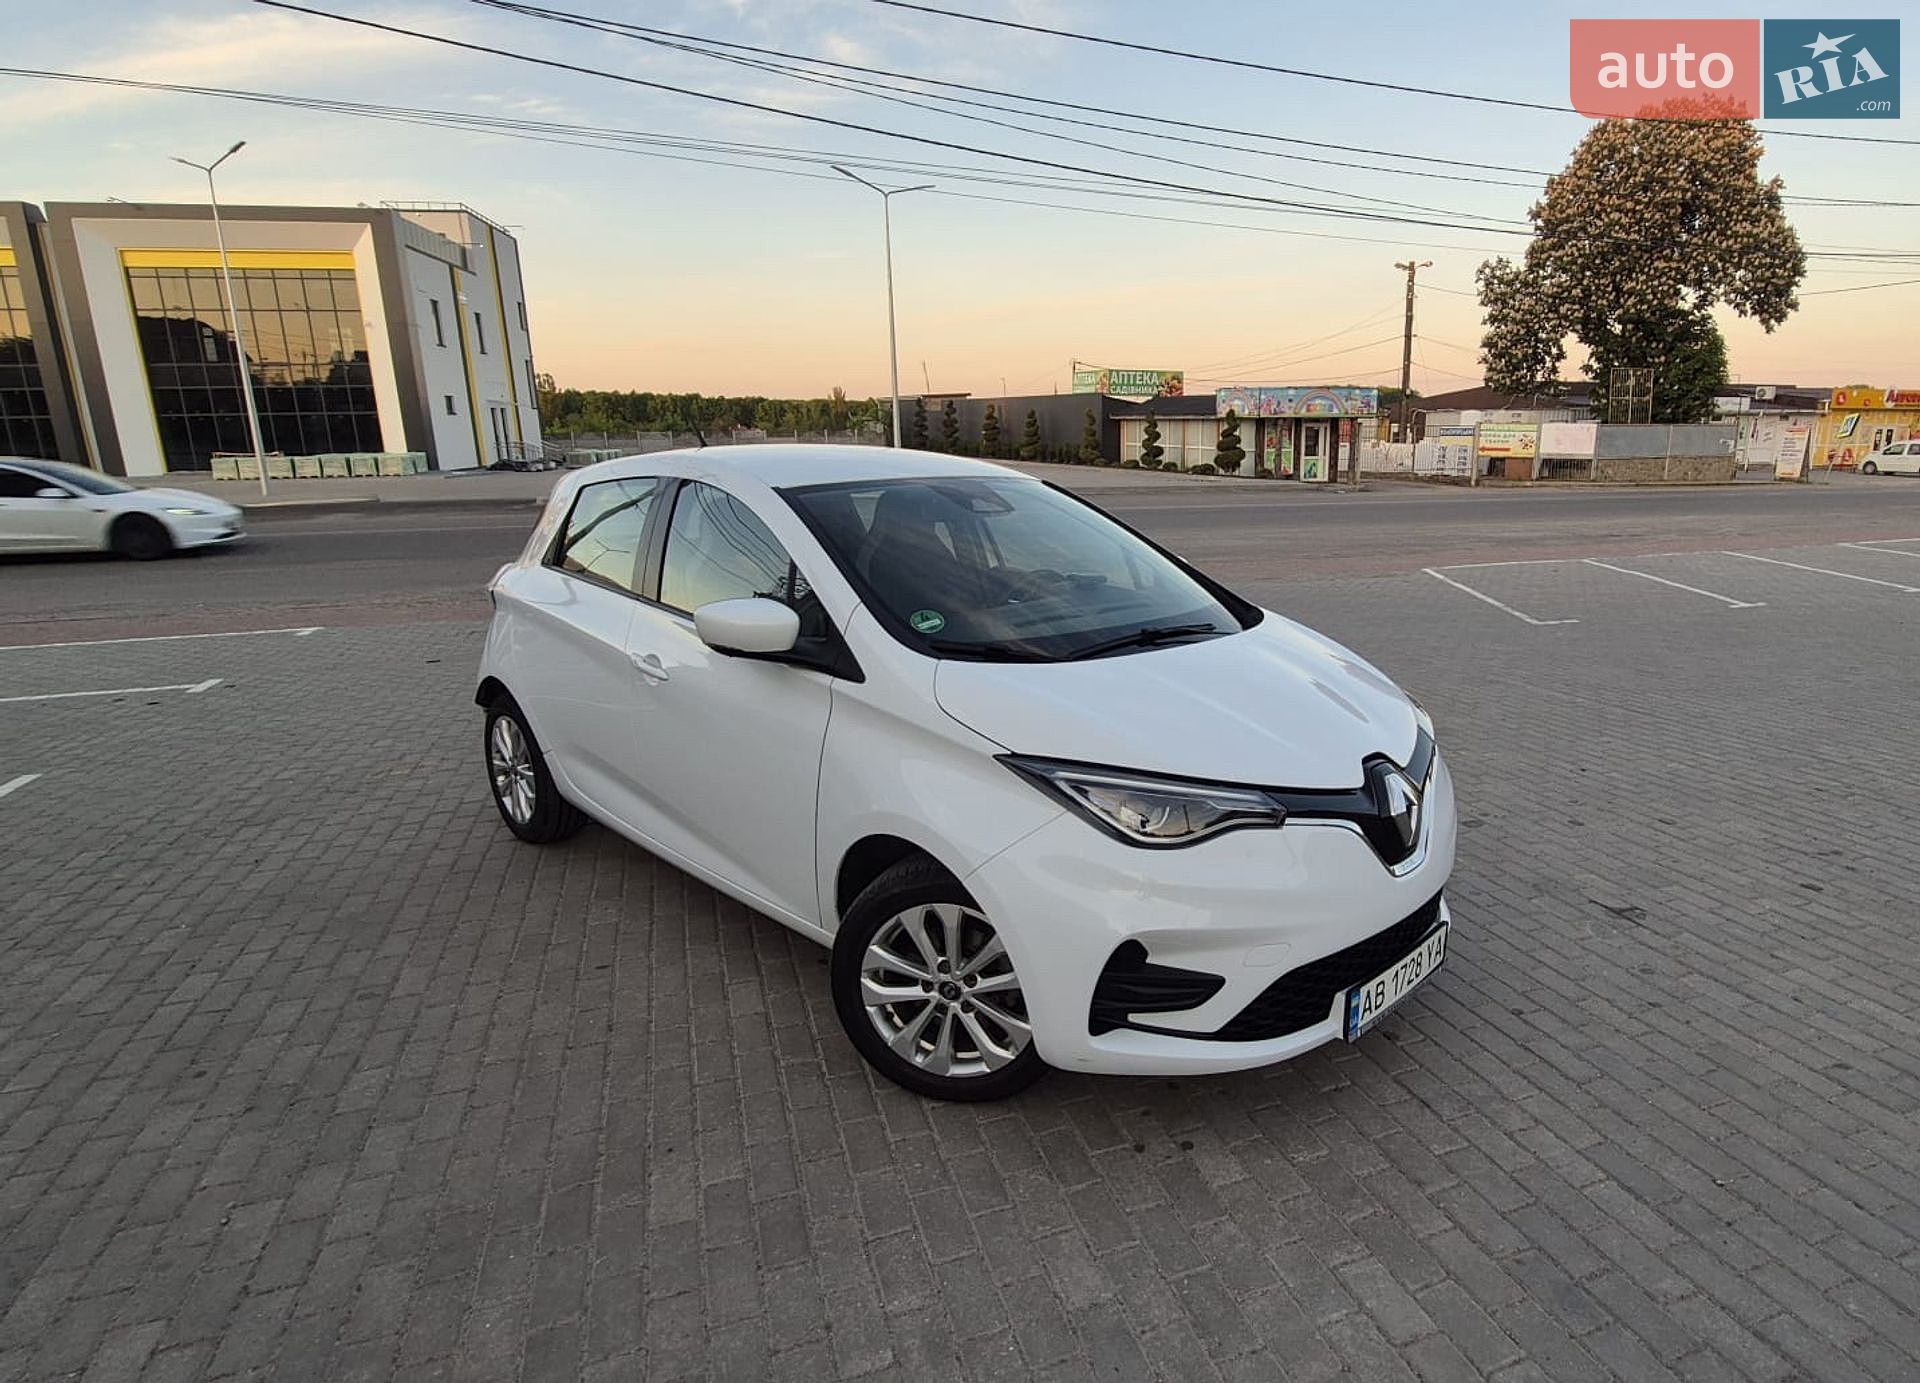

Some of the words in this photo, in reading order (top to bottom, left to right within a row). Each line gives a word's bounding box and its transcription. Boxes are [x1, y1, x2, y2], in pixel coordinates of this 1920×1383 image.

[1110, 371, 1159, 385] АПТЕКА
[1360, 980, 1386, 1021] AB
[1392, 951, 1423, 996] 1728
[1427, 936, 1442, 967] YA
